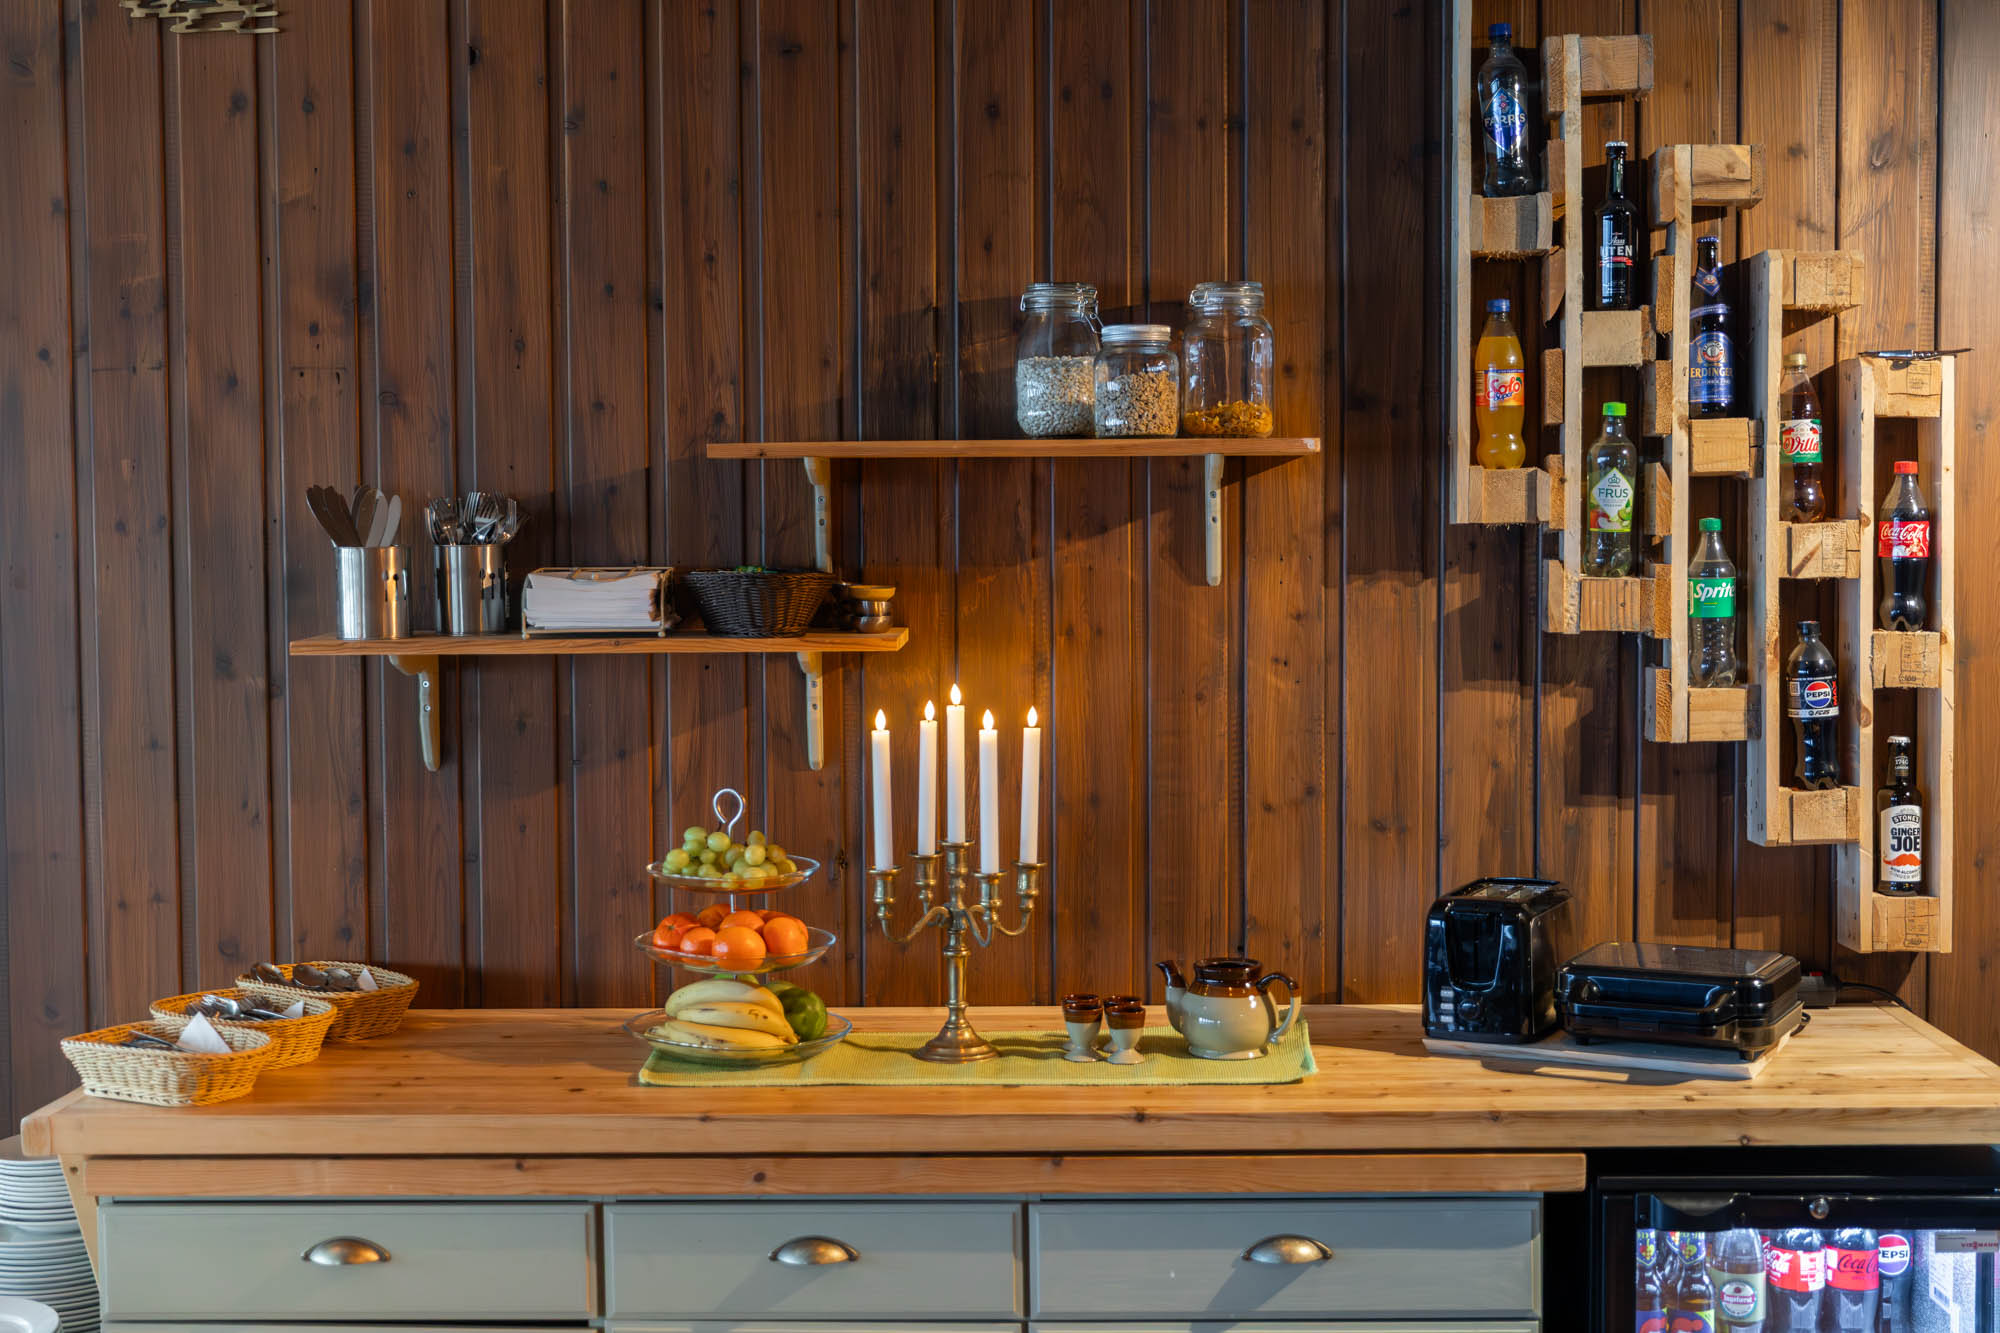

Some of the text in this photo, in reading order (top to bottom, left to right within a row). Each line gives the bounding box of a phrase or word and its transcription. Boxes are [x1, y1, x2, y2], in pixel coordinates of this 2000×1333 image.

[1484, 113, 1526, 127] FARRS
[1486, 376, 1521, 400] Solo
[1783, 436, 1820, 454] Villa
[1597, 488, 1629, 498] FRUS
[1806, 691, 1831, 699] PEPSI
[1890, 827, 1920, 836] GINGER
[1890, 836, 1920, 852] JOE
